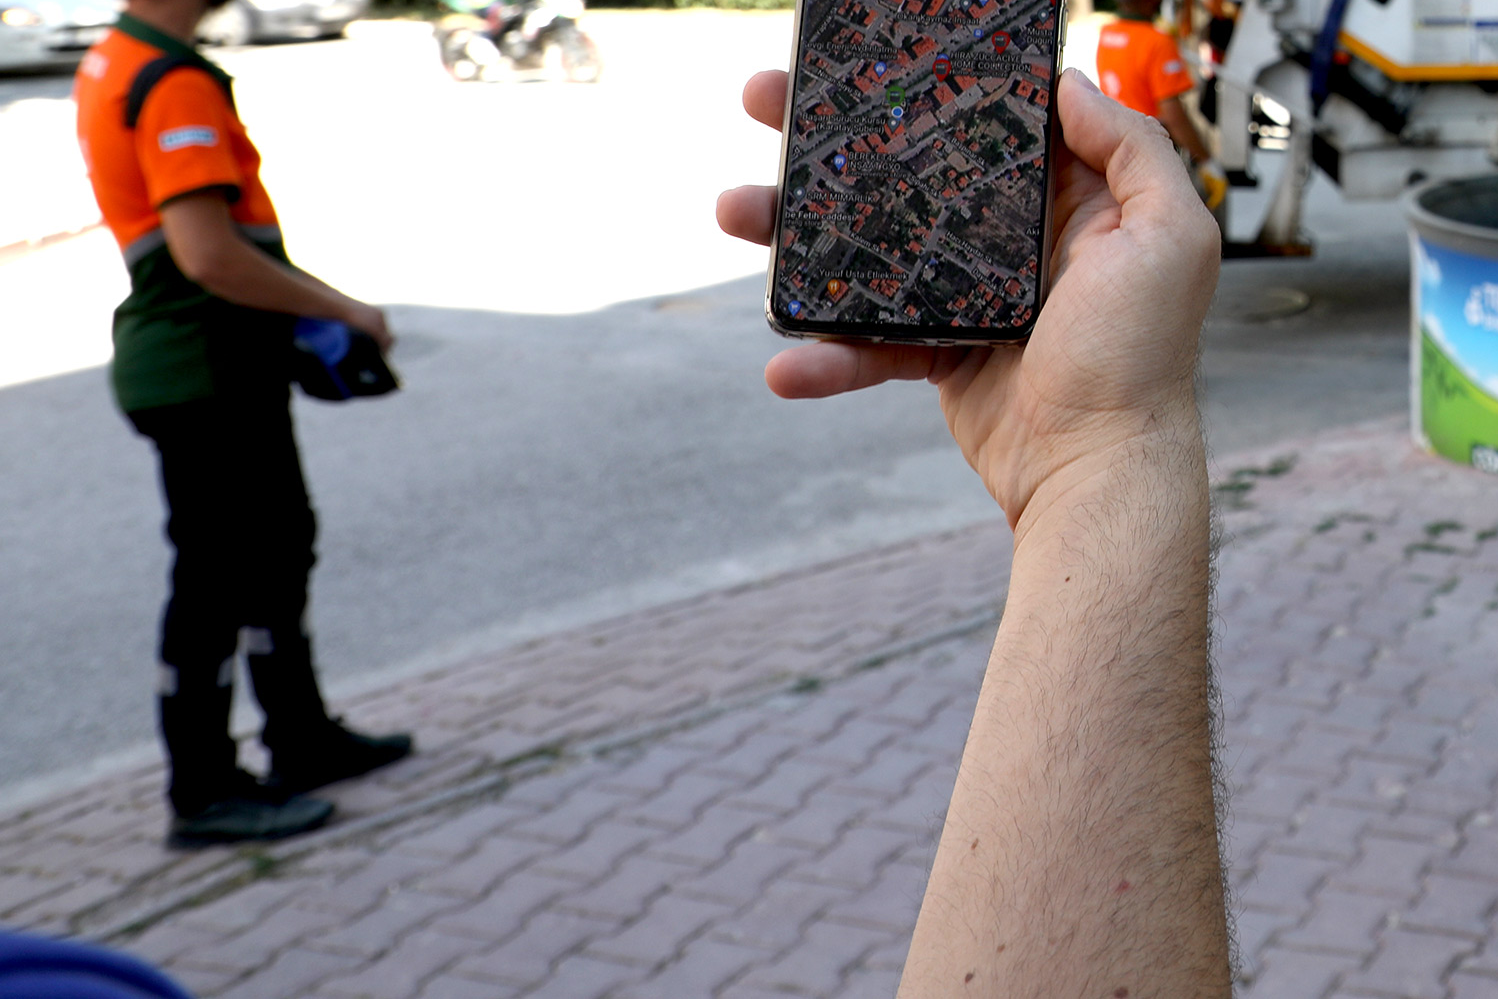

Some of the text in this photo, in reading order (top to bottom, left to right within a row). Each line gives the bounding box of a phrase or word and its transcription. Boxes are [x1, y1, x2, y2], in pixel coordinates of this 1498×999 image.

[897, 13, 919, 21] Okan
[920, 14, 952, 24] Kaymaz
[950, 60, 1031, 73] HOME COLLECTION
[861, 115, 886, 124] Kursu
[819, 268, 844, 277] Yusuf
[845, 268, 865, 278] Usta
